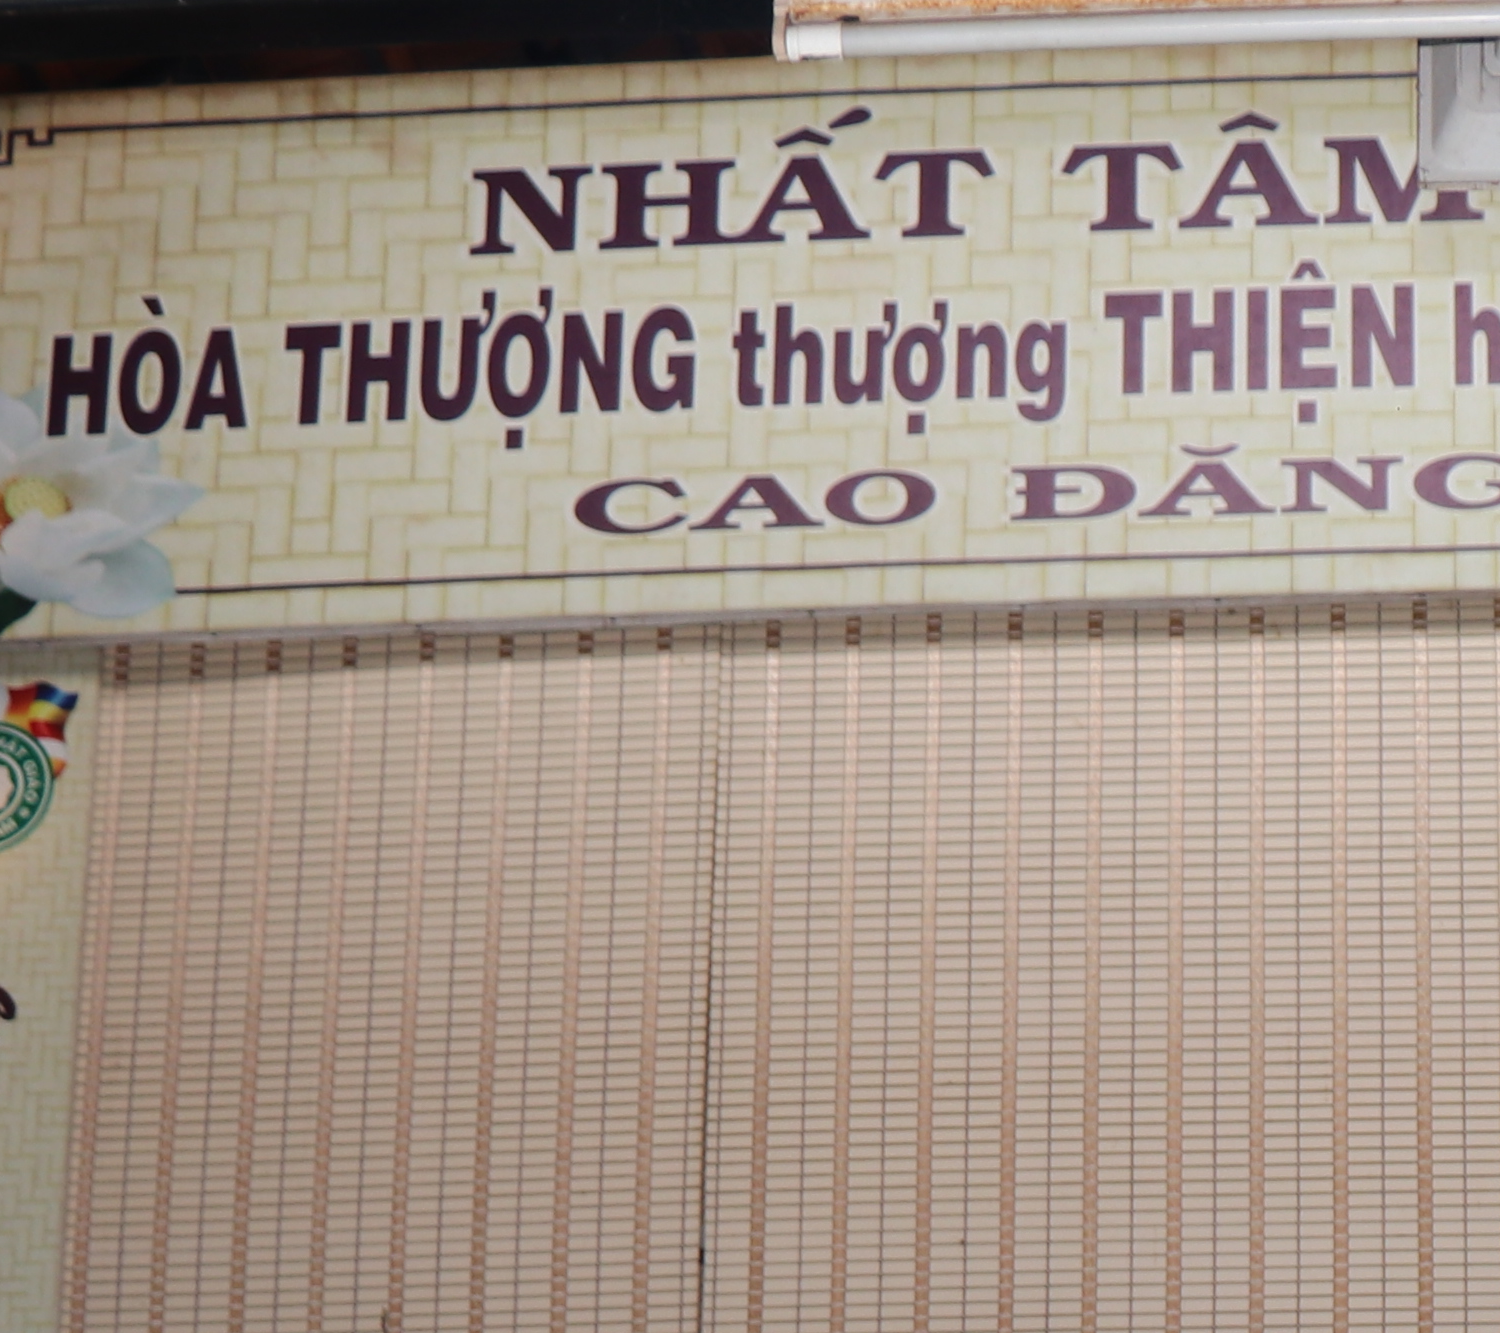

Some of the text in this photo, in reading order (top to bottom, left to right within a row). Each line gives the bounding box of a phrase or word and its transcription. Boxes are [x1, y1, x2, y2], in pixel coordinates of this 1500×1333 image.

[470, 106, 994, 256] NHẤT
[1062, 111, 1484, 232] TÂM
[47, 295, 247, 437] HÒA
[286, 286, 696, 450] THƯỢNG
[733, 301, 1066, 435] thượng
[1104, 259, 1414, 423] THIỆN
[575, 468, 936, 534] CAO
